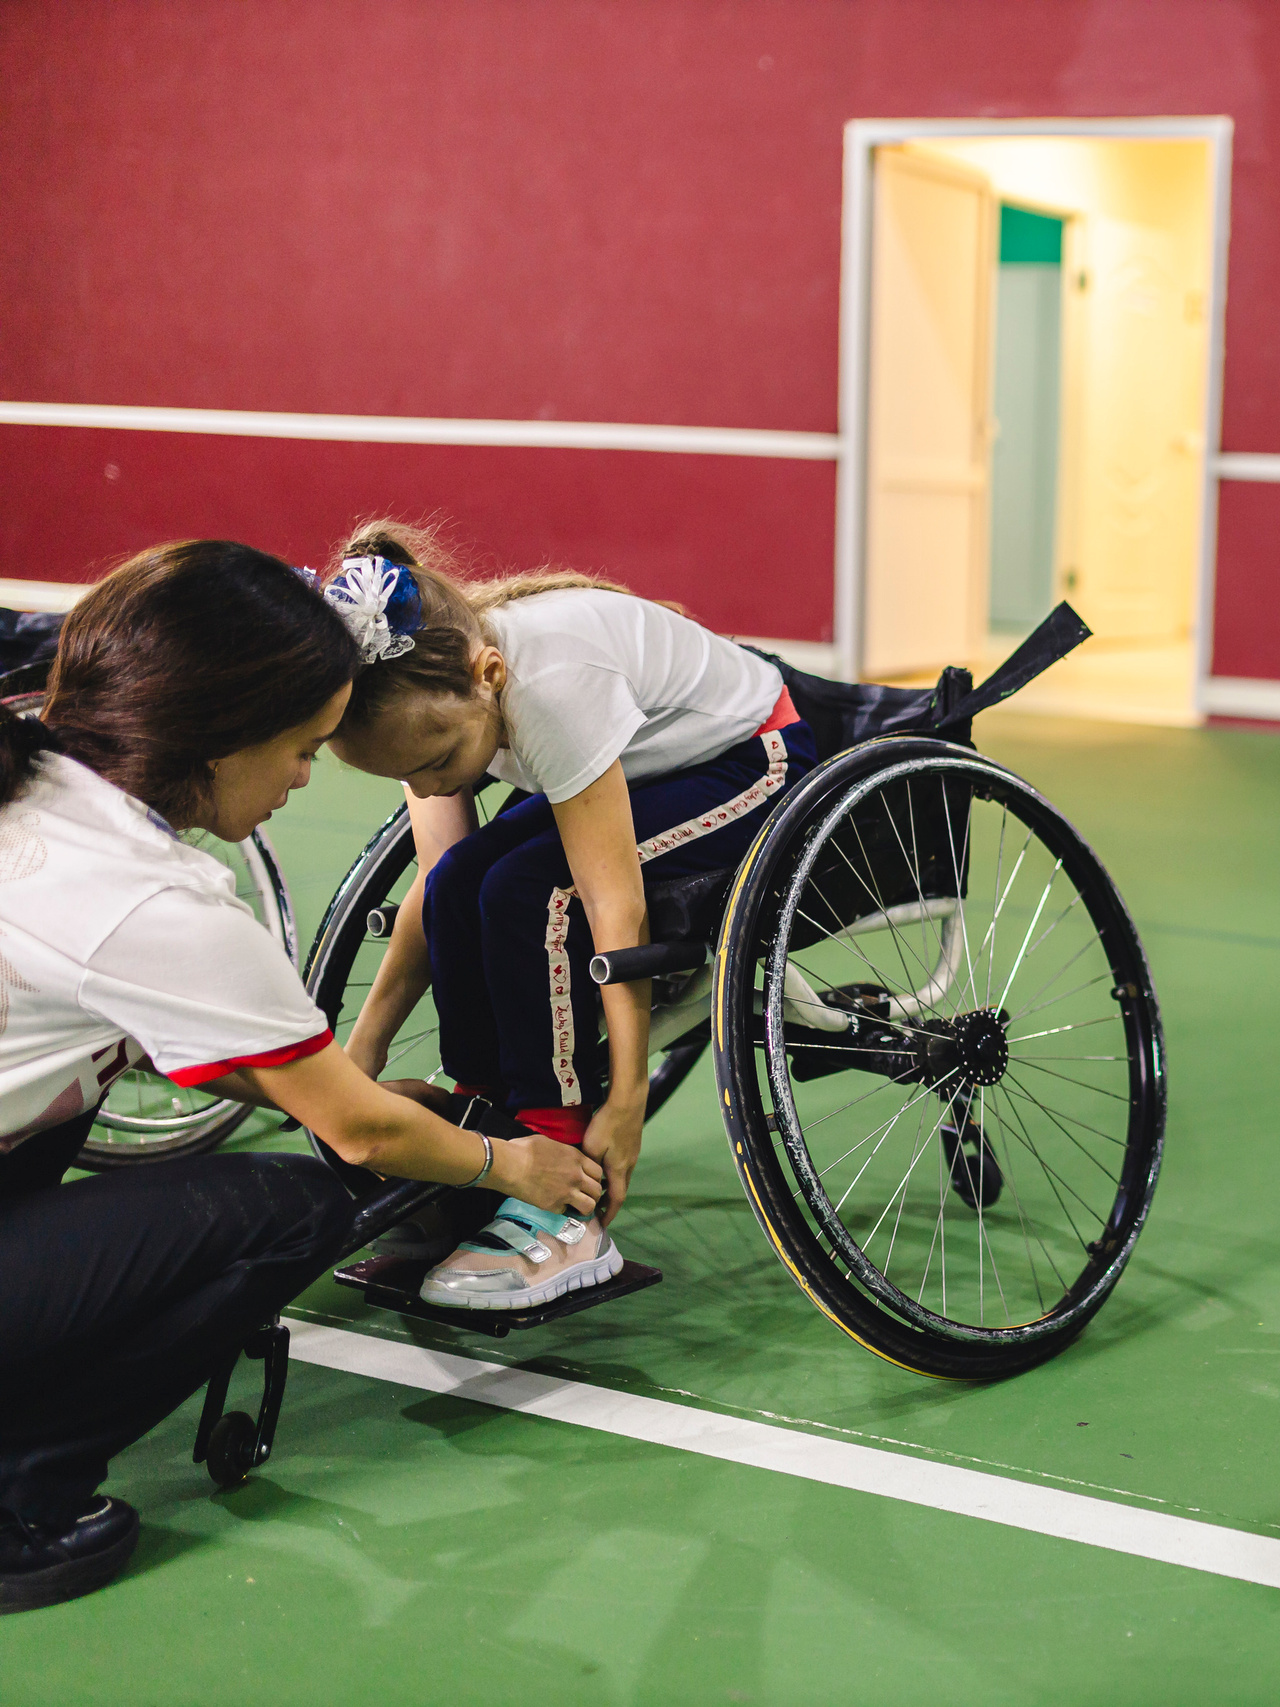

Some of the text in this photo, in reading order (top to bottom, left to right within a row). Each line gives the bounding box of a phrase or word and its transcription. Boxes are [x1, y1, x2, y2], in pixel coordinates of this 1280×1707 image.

[744, 788, 761, 801] ucky
[652, 826, 694, 852] Lucky Child
[554, 1004, 570, 1054] Lucky Child
